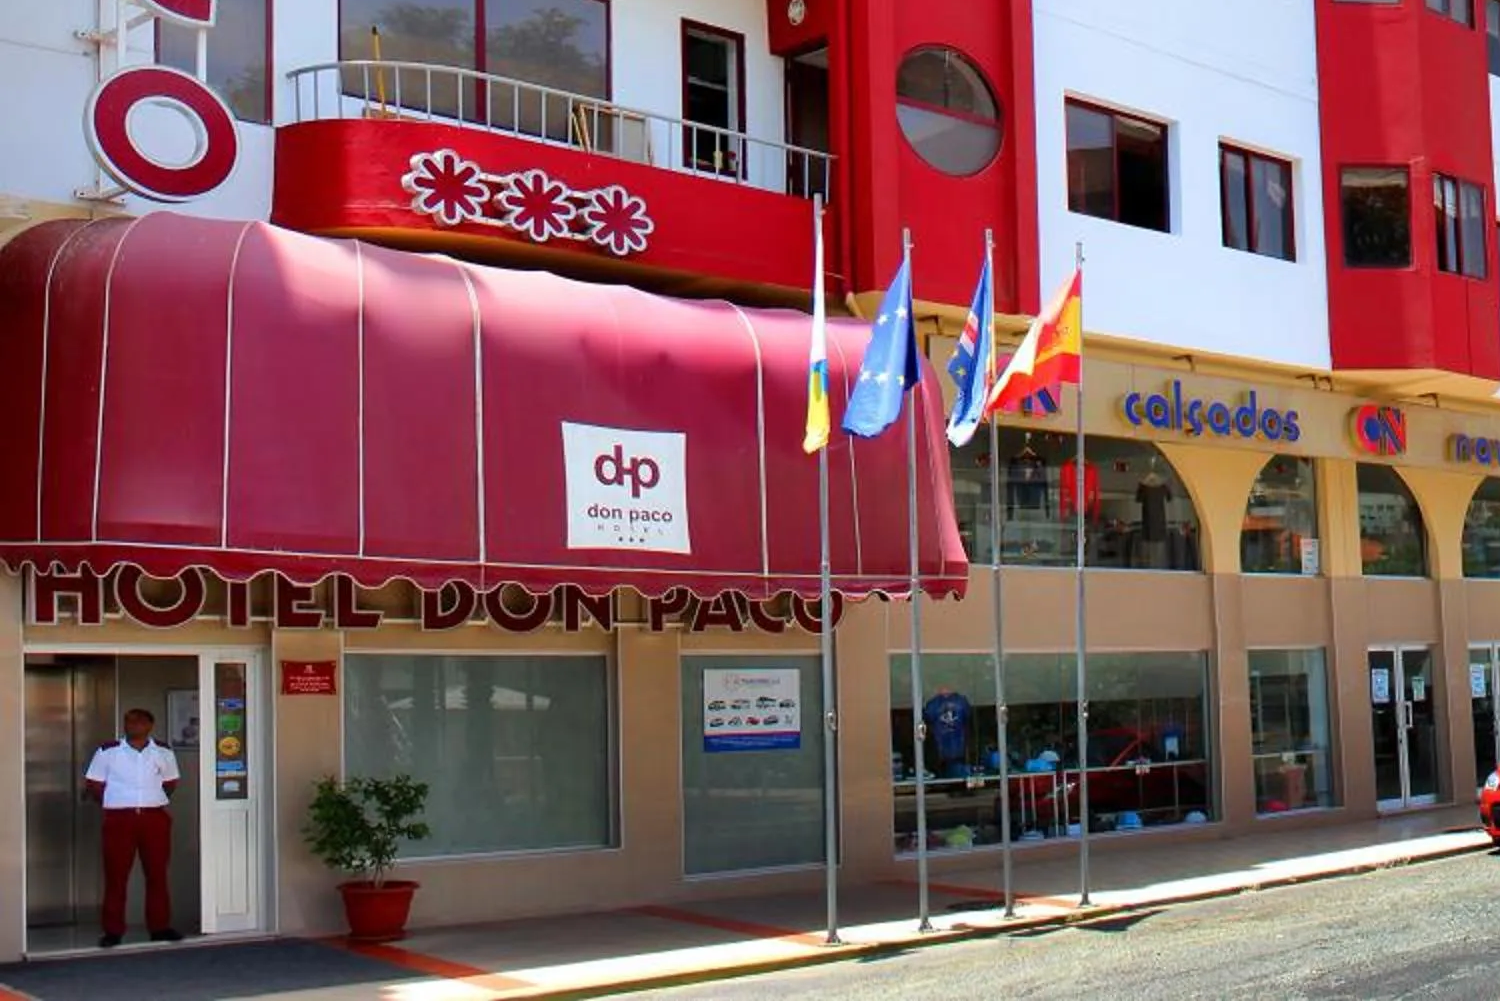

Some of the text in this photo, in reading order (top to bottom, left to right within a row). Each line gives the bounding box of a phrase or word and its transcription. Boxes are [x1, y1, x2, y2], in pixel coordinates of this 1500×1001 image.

[587, 502, 673, 525] don paco
[421, 578, 614, 634] DON
